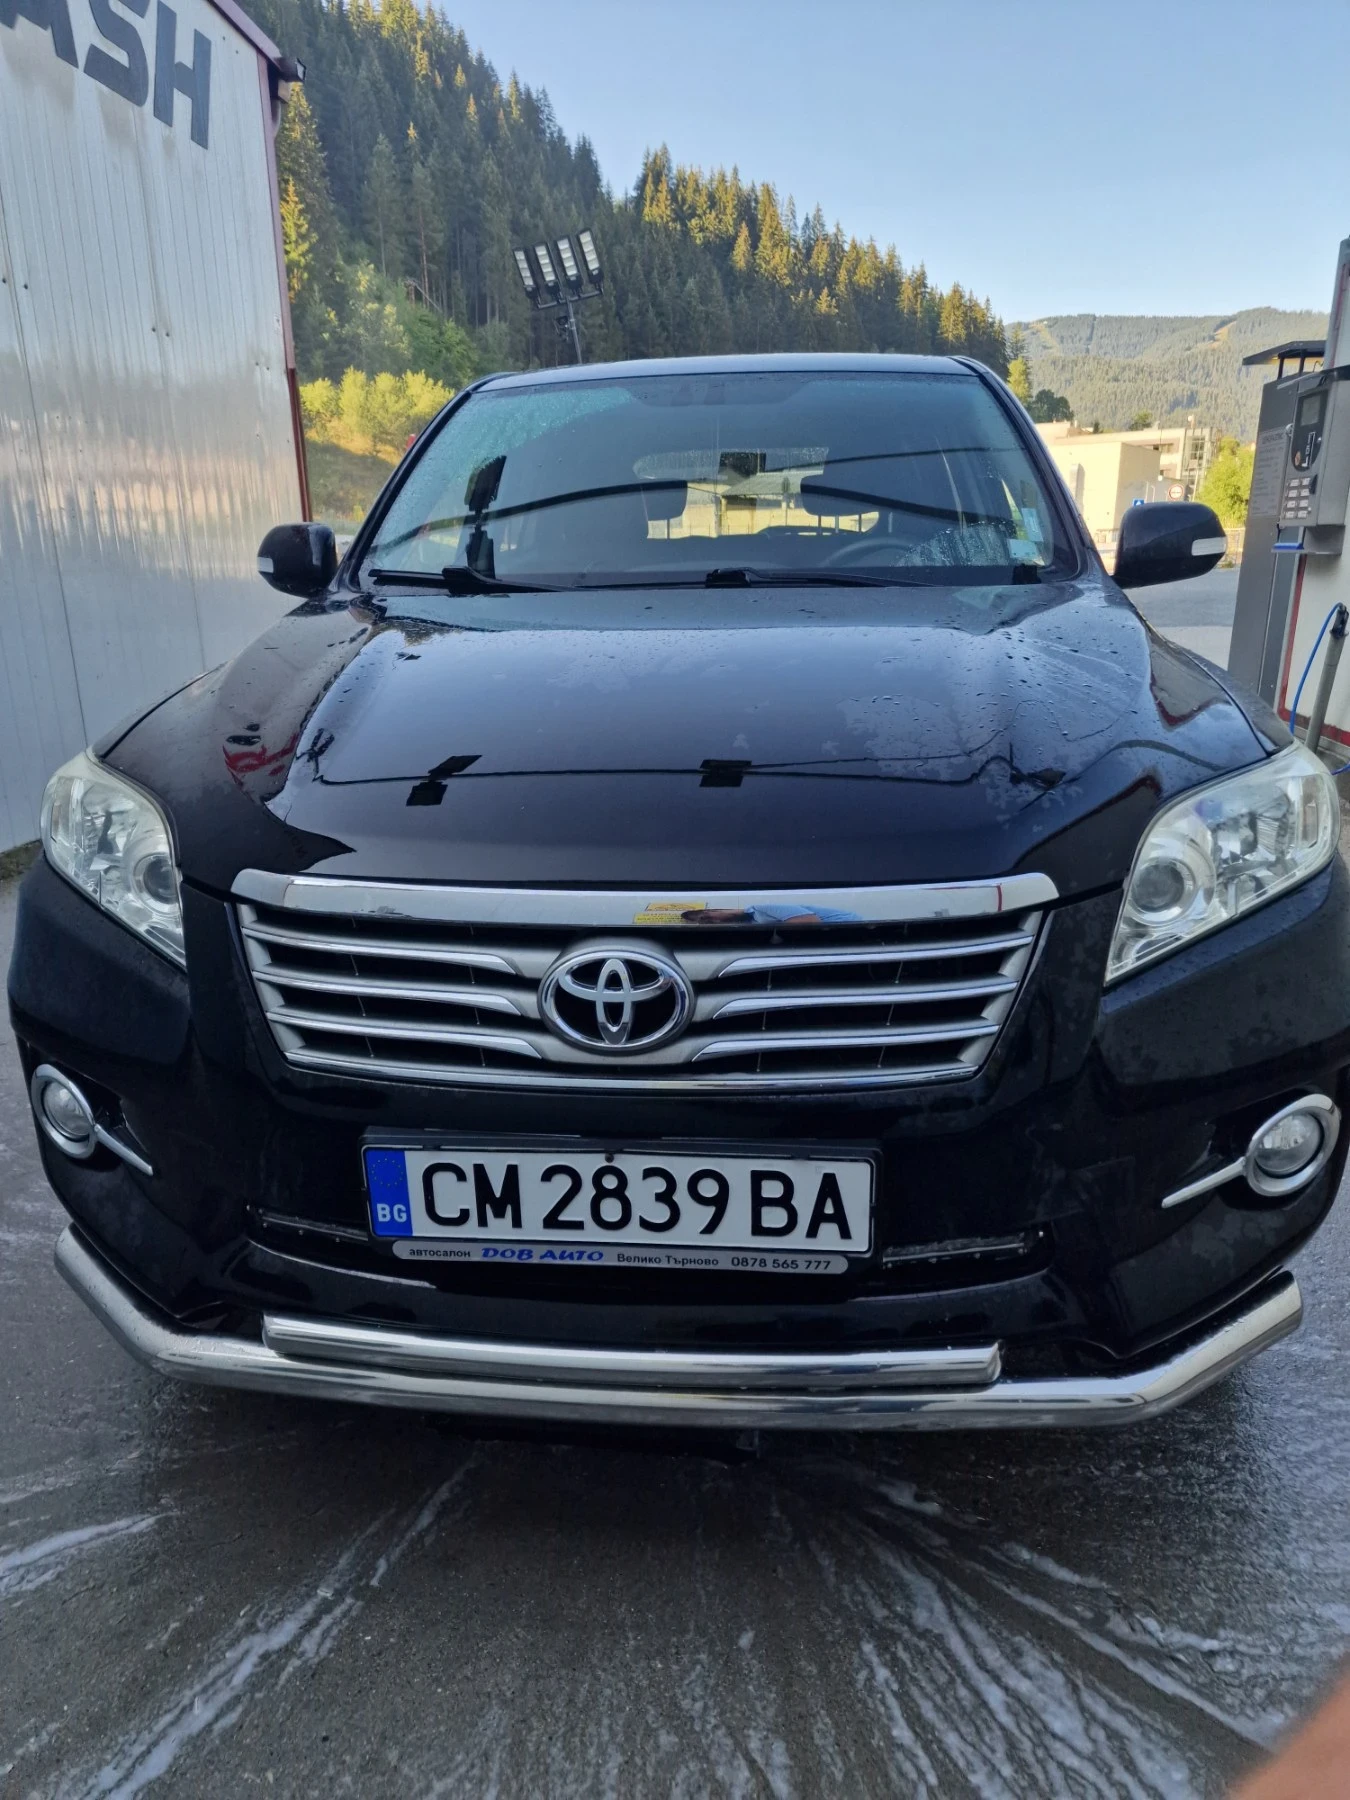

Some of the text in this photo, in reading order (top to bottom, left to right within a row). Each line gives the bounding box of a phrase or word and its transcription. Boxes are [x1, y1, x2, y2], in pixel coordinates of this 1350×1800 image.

[422, 1162, 852, 1240] CM 2839 BA
[376, 1203, 408, 1223] BG
[409, 1248, 471, 1258] автосалон
[617, 1253, 662, 1264] Велико
[665, 1254, 719, 1267] Търново
[731, 1257, 767, 1268] 0878
[772, 1258, 799, 1269] 565
[804, 1260, 831, 1270] 777
